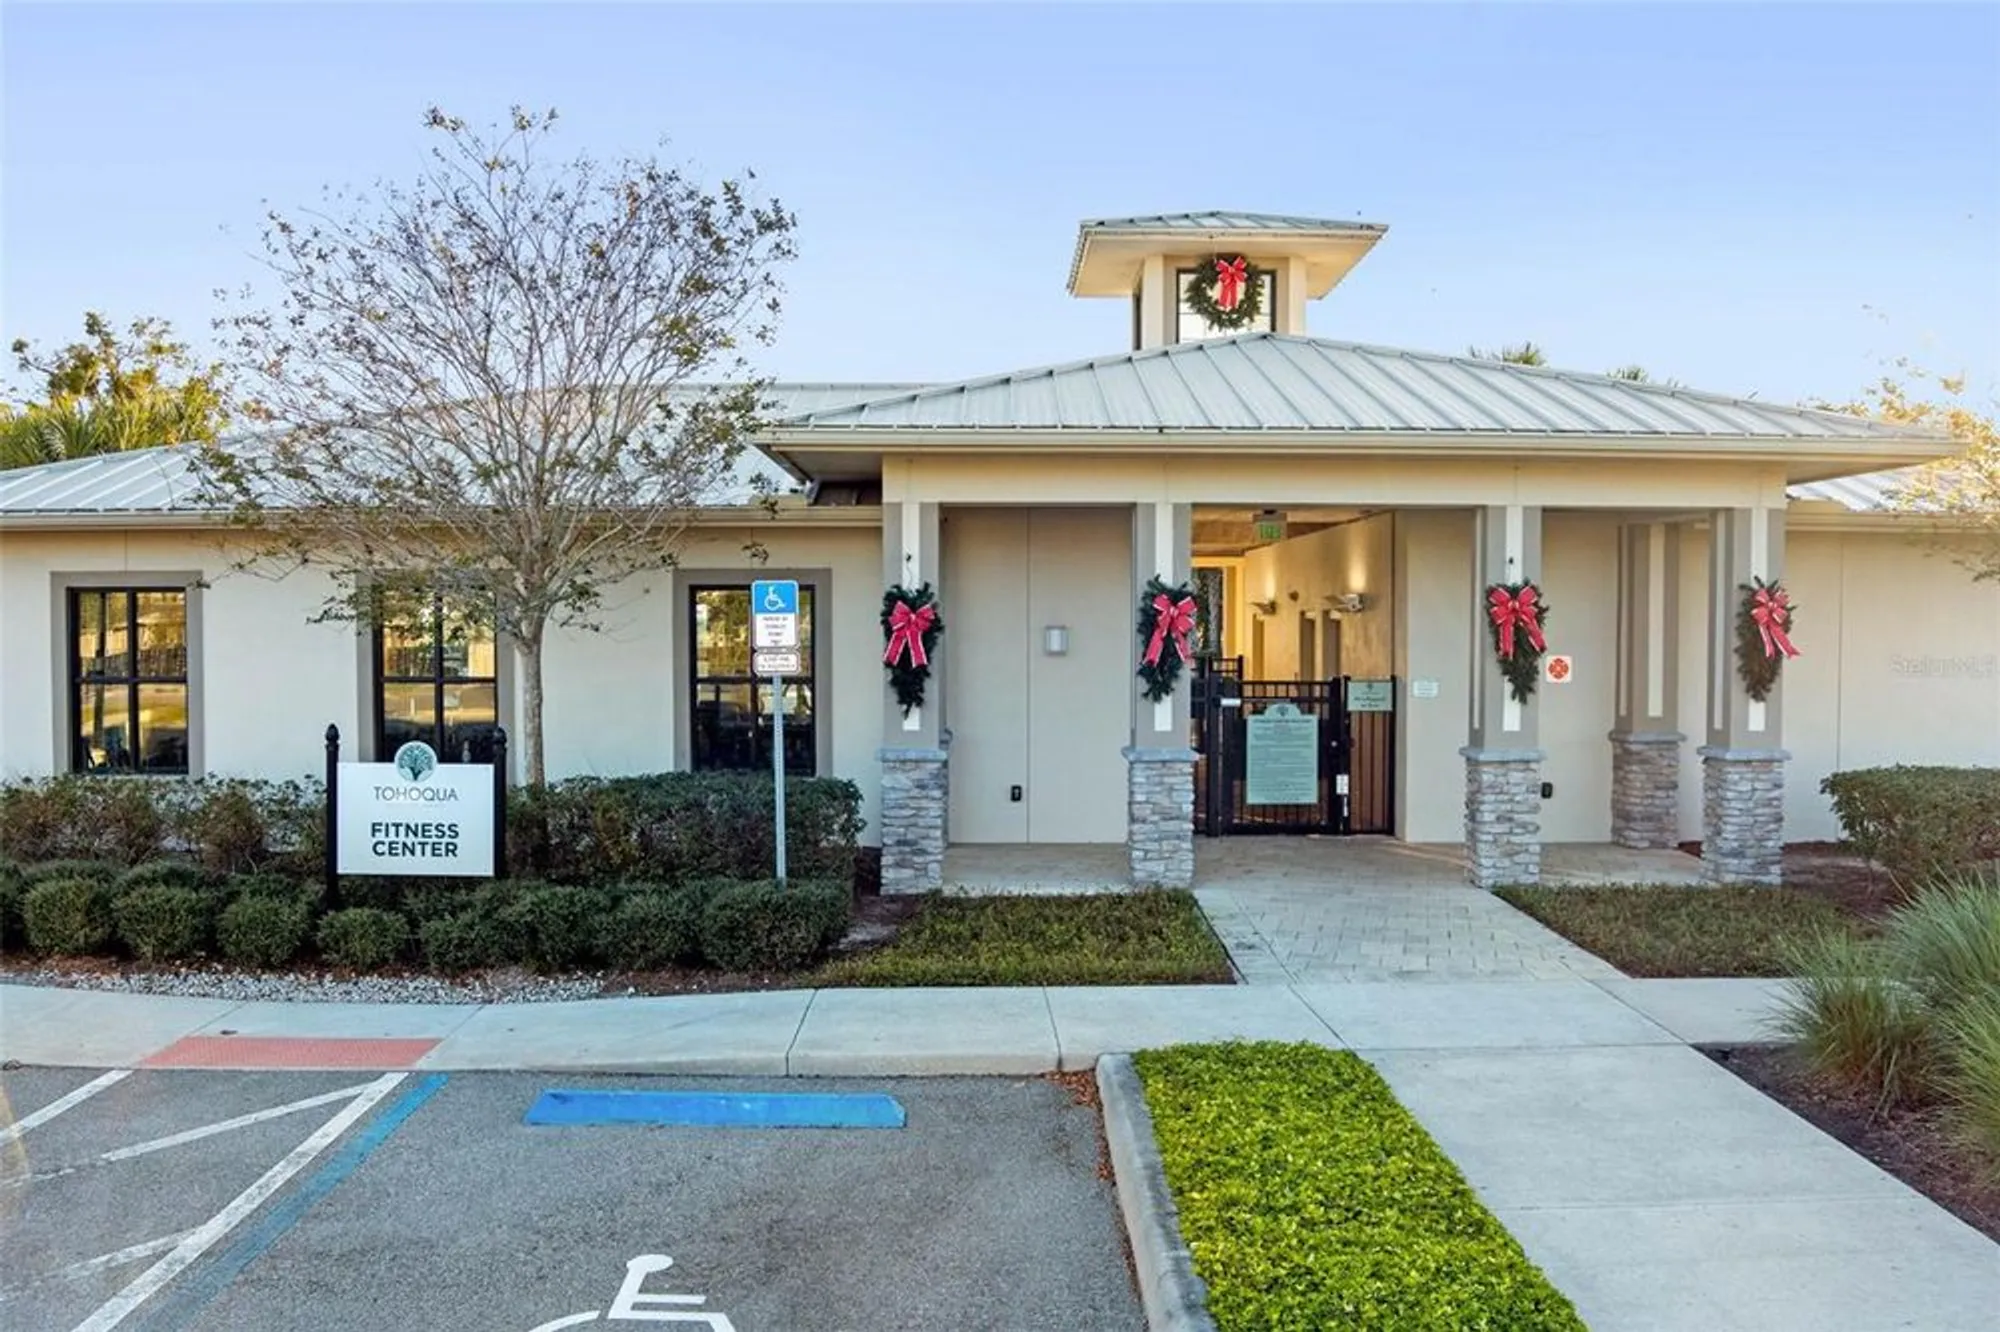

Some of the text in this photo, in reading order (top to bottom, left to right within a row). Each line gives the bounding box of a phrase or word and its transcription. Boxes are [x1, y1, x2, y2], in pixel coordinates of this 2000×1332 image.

[374, 786, 459, 801] TOHOQUA
[371, 822, 460, 839] FITNESS
[371, 839, 459, 857] CENTER
